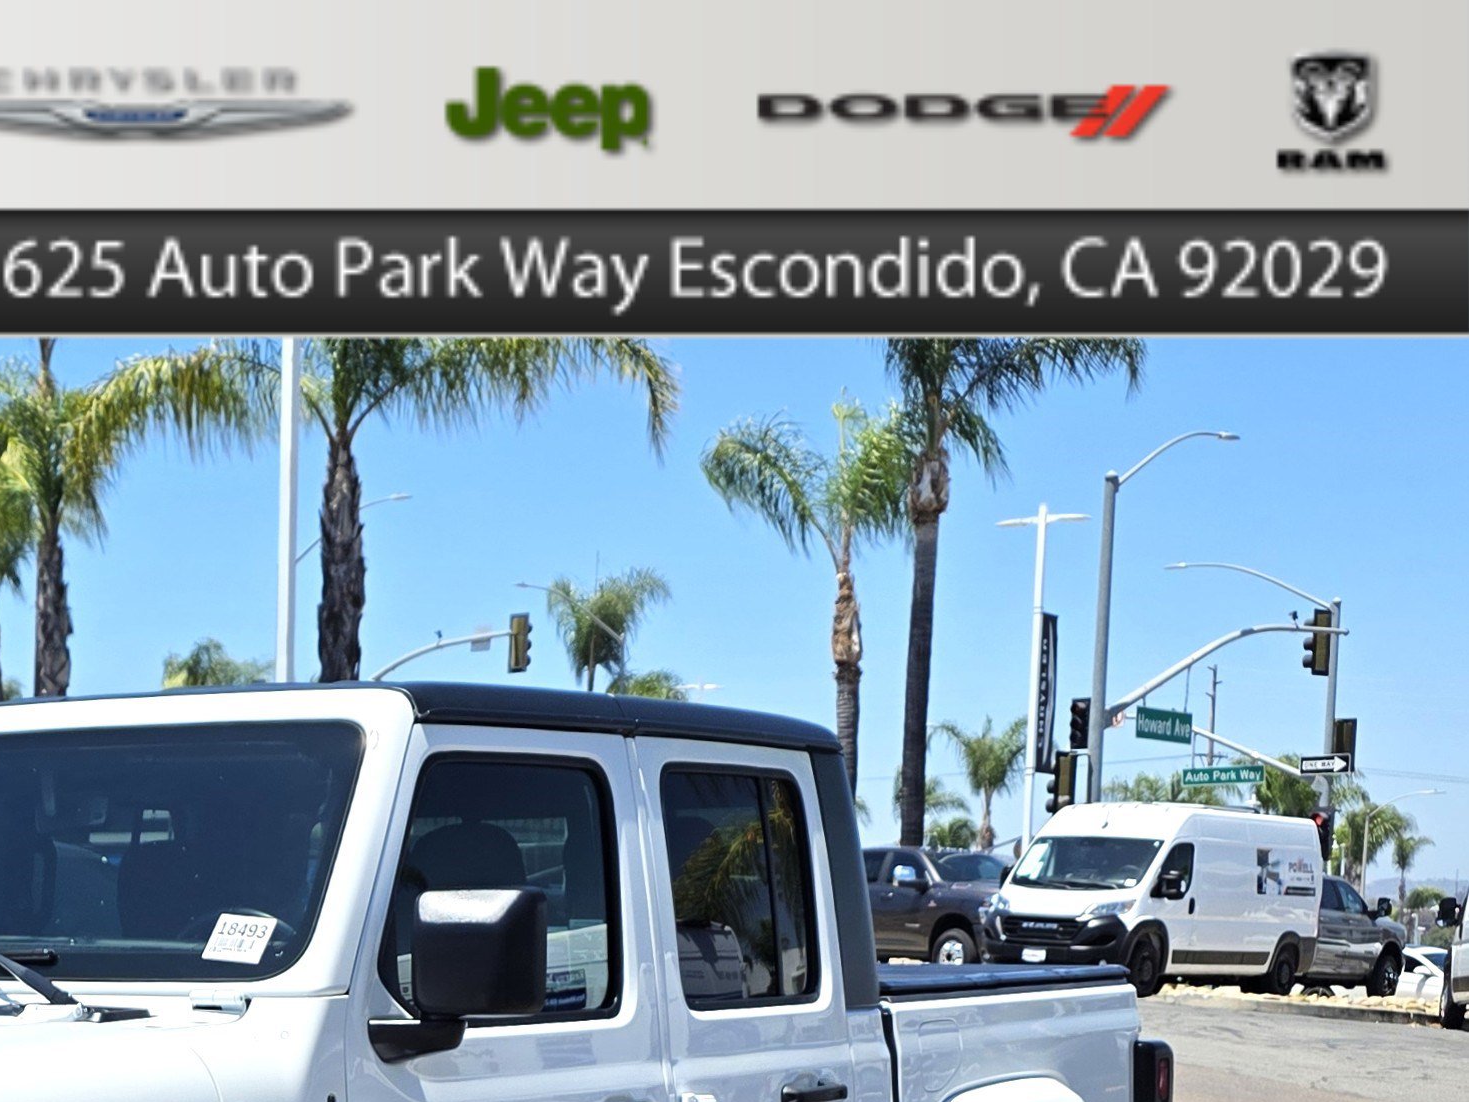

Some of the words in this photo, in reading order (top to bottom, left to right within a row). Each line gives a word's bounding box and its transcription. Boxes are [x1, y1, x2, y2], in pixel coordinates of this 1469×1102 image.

[1137, 714, 1173, 736] Howard
[1174, 718, 1191, 739] Ave
[1304, 761, 1319, 769] ONE
[1321, 760, 1336, 768] WAY
[1185, 770, 1209, 782] Auto
[1213, 769, 1237, 780] Park
[1240, 767, 1262, 780] Way
[218, 922, 268, 938] 18493
